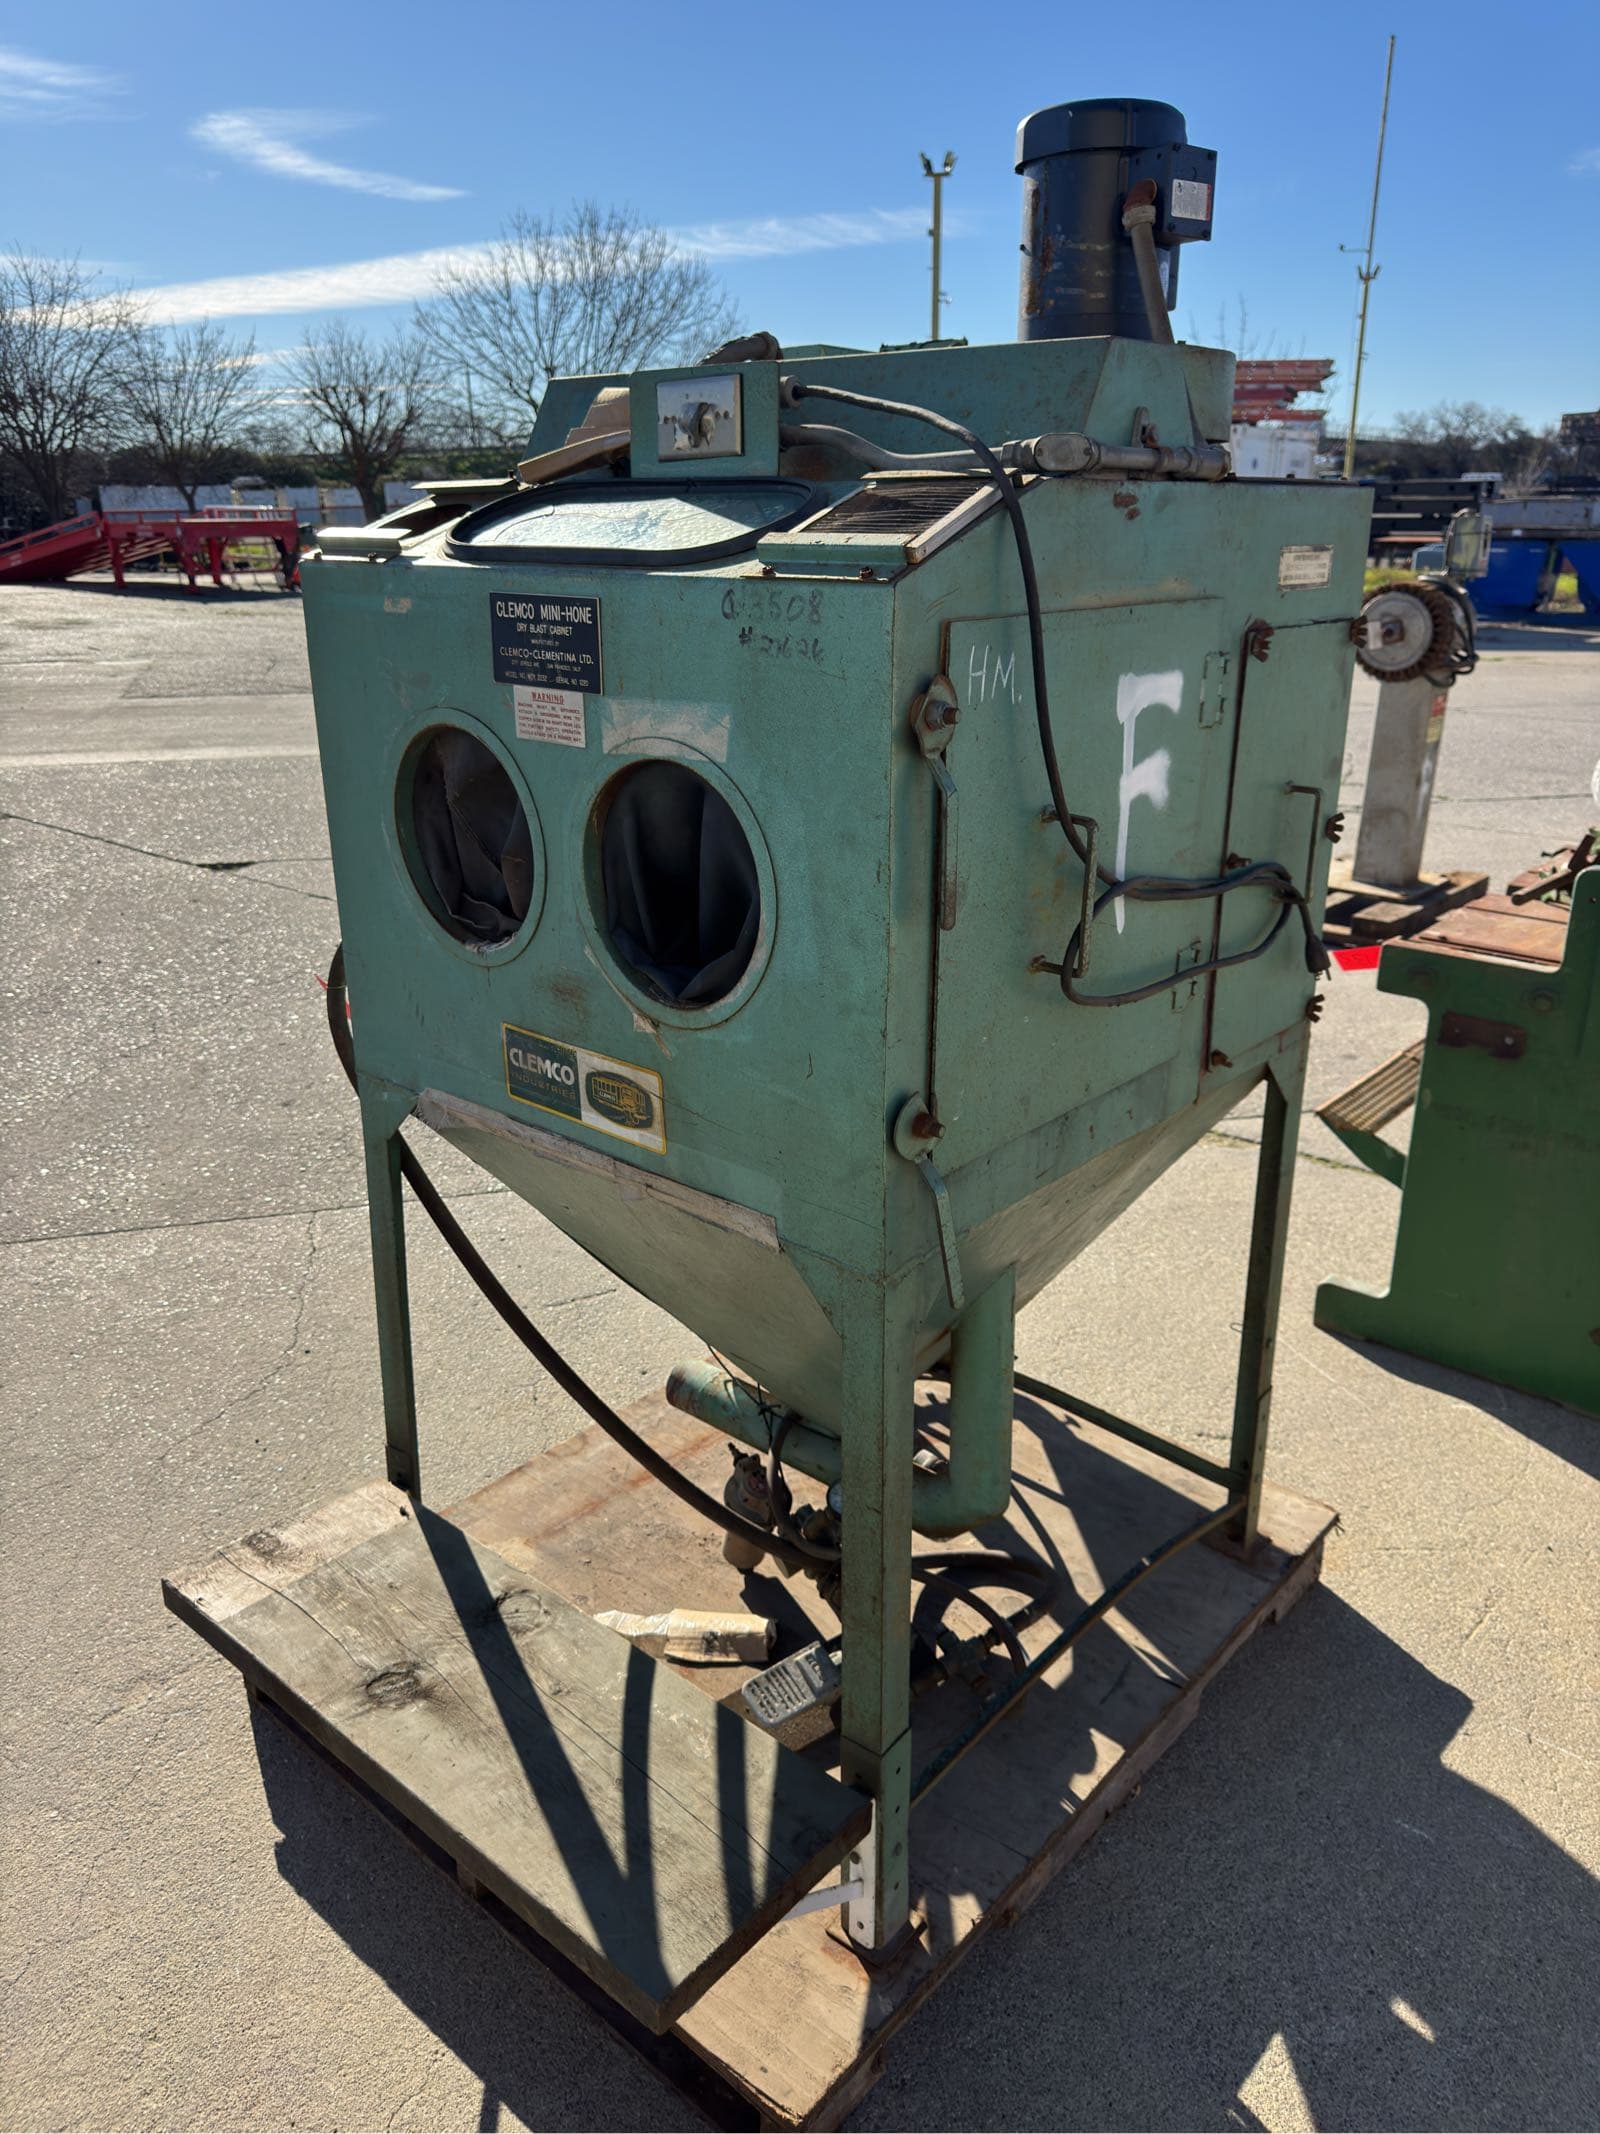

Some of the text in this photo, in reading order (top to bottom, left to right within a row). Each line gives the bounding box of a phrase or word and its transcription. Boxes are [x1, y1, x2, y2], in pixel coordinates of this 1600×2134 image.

[496, 601, 593, 625] CLEMCO MINI-HONE
[516, 622, 573, 636] DRY BLAST CABINET
[500, 646, 577, 664] CLEMCO-CLEMENTINA
[579, 654, 595, 665] LTD.
[532, 692, 564, 704] WARNING
[509, 1047, 576, 1086] CLEMCO
